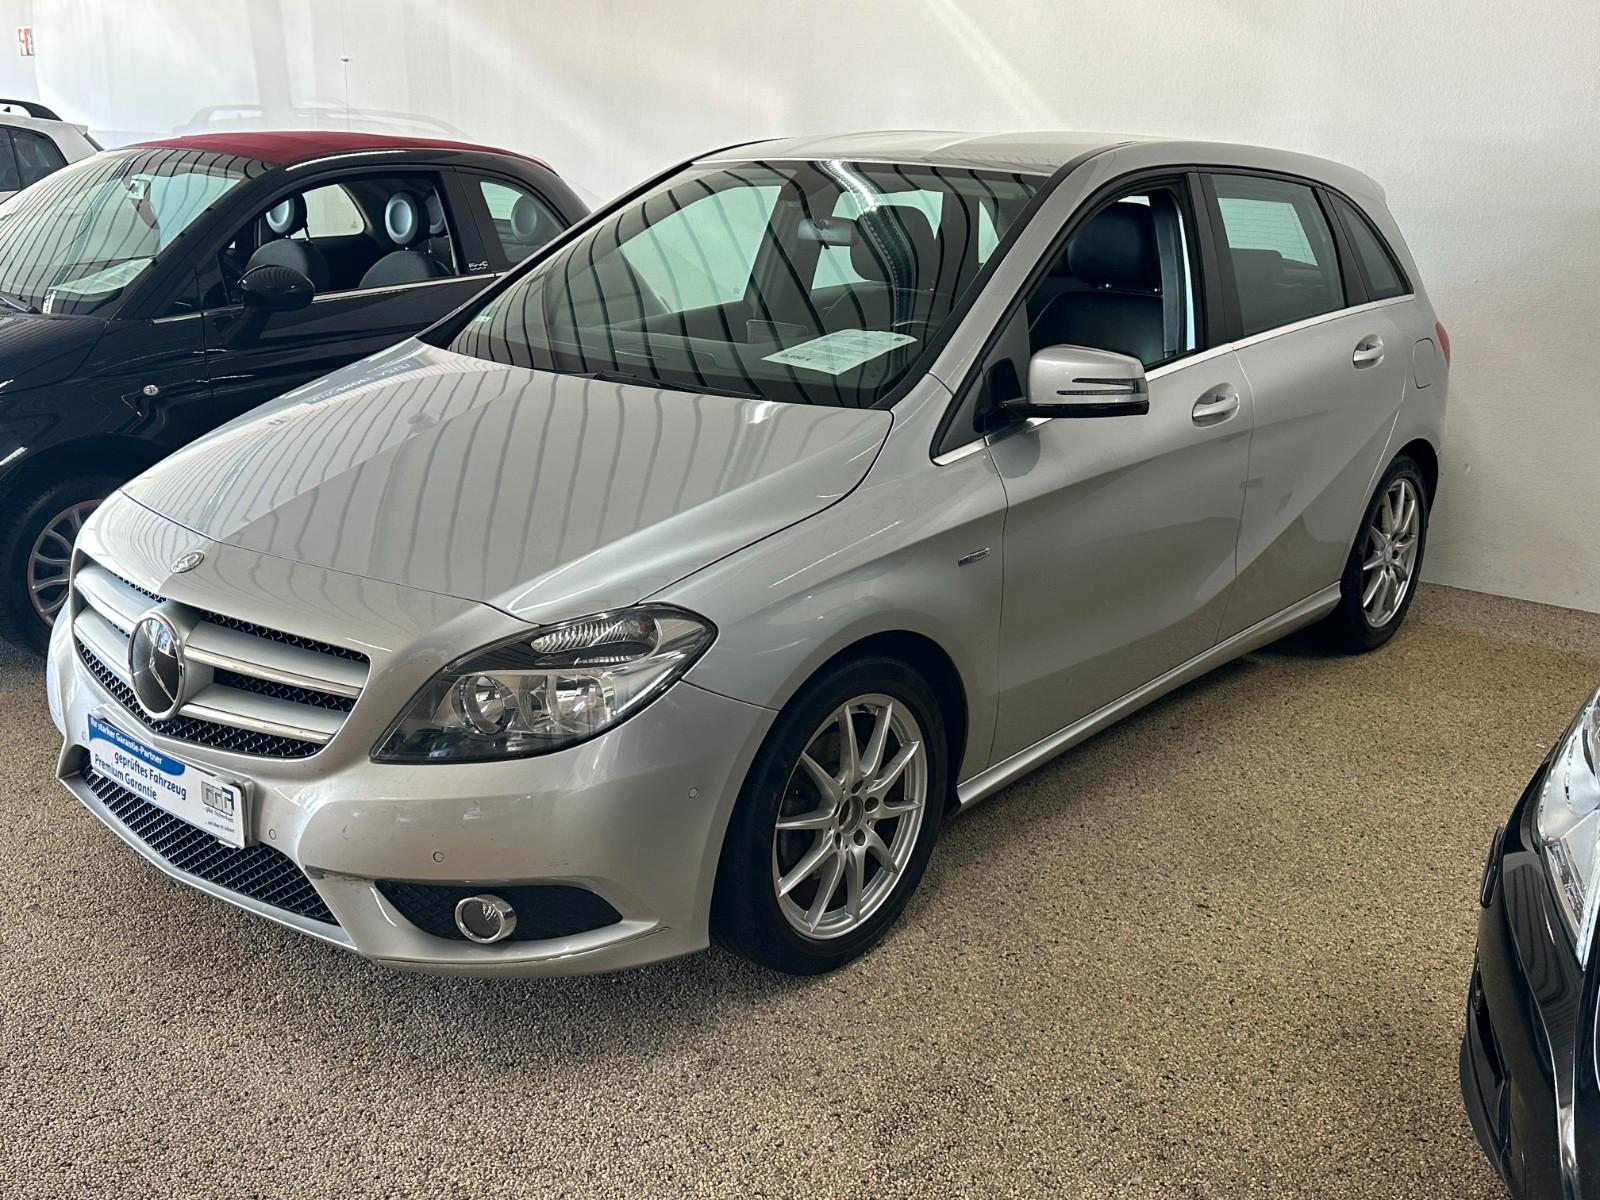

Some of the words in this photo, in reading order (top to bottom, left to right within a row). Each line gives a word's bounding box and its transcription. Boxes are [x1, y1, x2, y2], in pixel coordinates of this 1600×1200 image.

[94, 753, 124, 781] Premium
[124, 772, 157, 800] Garantie
[114, 752, 148, 778] geprüftes
[149, 768, 187, 801] Fahrzeug
